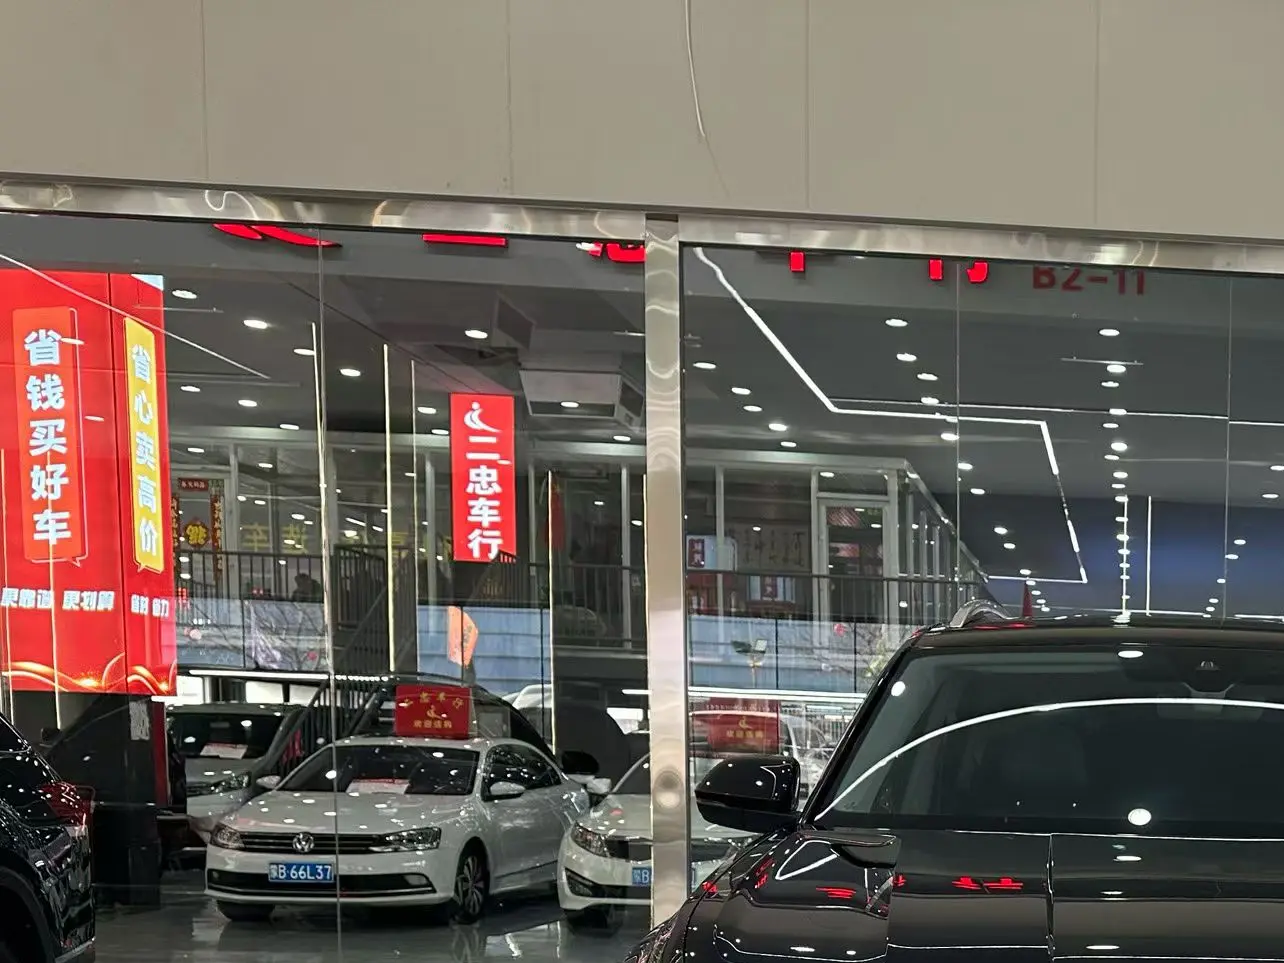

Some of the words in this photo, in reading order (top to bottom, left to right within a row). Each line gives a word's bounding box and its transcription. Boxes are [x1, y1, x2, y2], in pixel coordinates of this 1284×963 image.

[24, 328, 72, 545] 省钱买好车
[131, 343, 159, 557] 省心卖高价
[466, 435, 502, 559] 二忠车行
